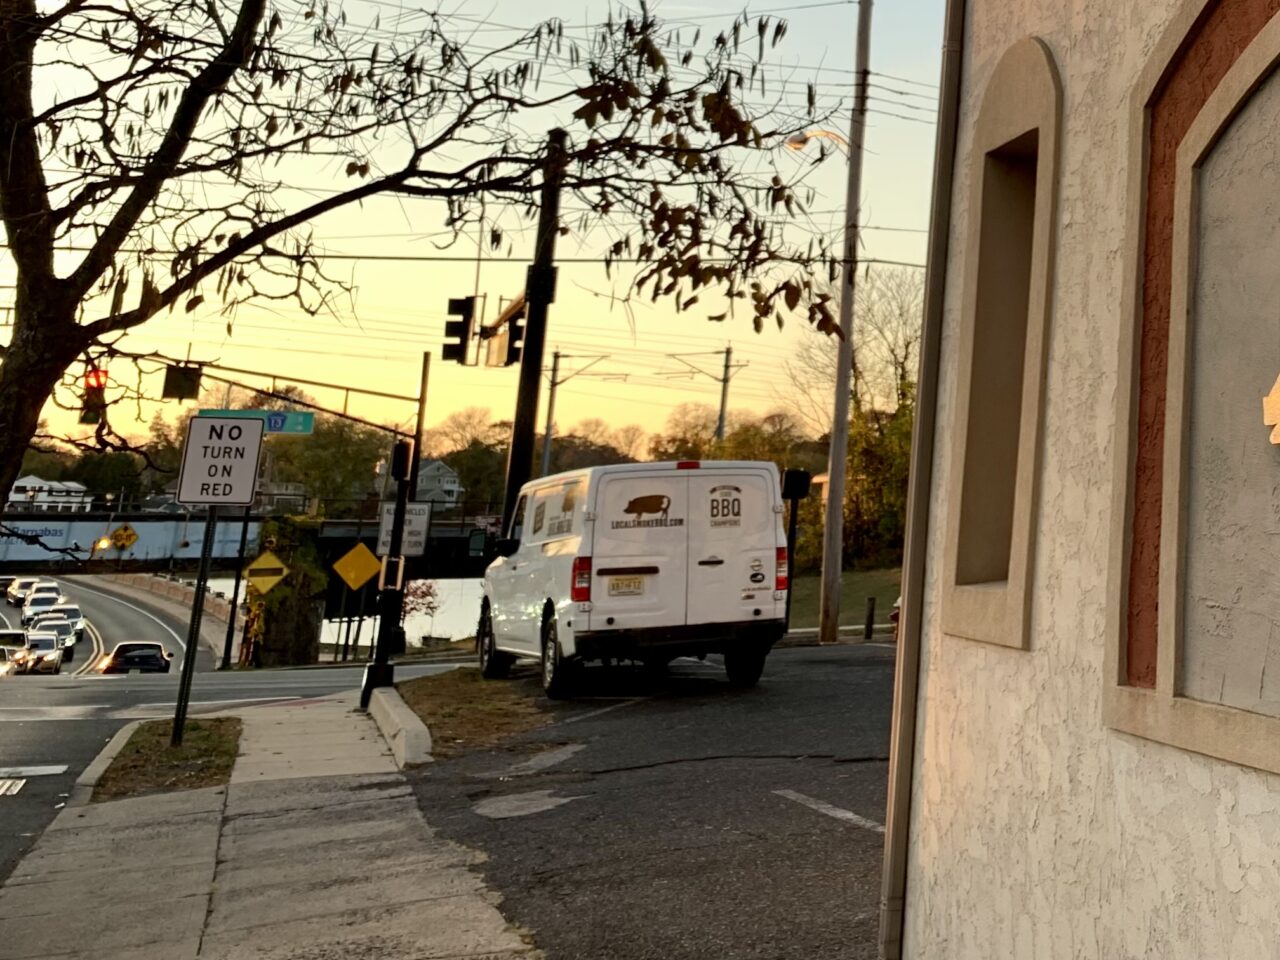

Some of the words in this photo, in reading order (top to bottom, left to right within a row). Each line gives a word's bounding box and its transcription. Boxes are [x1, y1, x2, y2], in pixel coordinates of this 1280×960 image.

[208, 424, 243, 441] NO
[202, 445, 246, 460] TURN
[207, 464, 233, 478] ON
[200, 482, 233, 497] RED
[710, 497, 742, 518] BBQ
